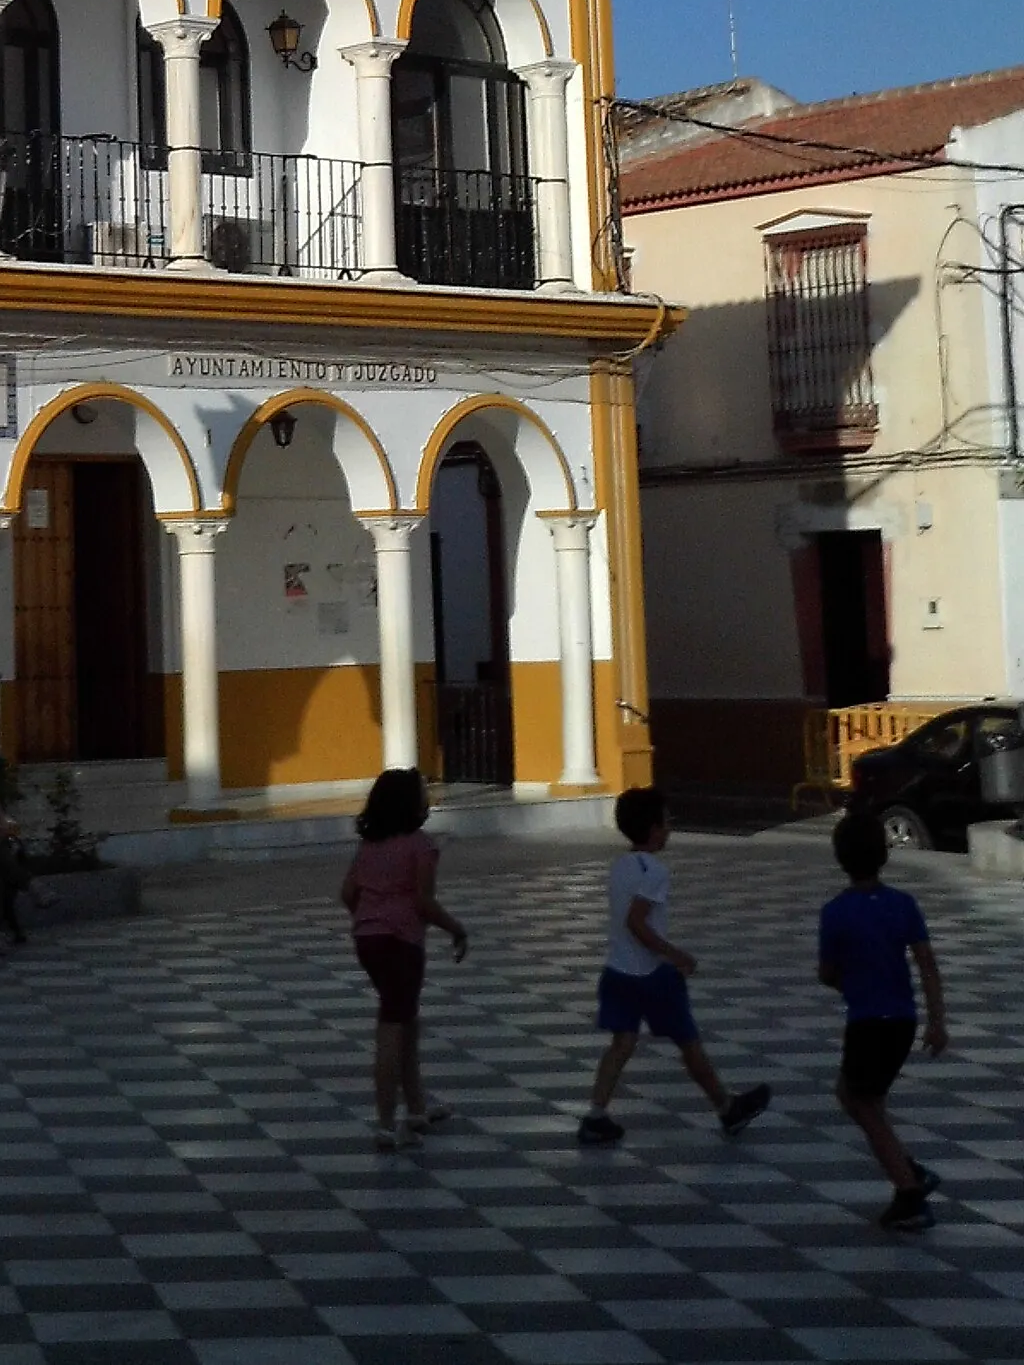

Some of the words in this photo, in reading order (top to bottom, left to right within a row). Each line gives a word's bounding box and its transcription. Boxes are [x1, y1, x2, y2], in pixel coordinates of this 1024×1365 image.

[172, 357, 326, 380] AYUNTAMIENTO
[336, 364, 345, 380] Y
[354, 364, 436, 383] JUZGADO
